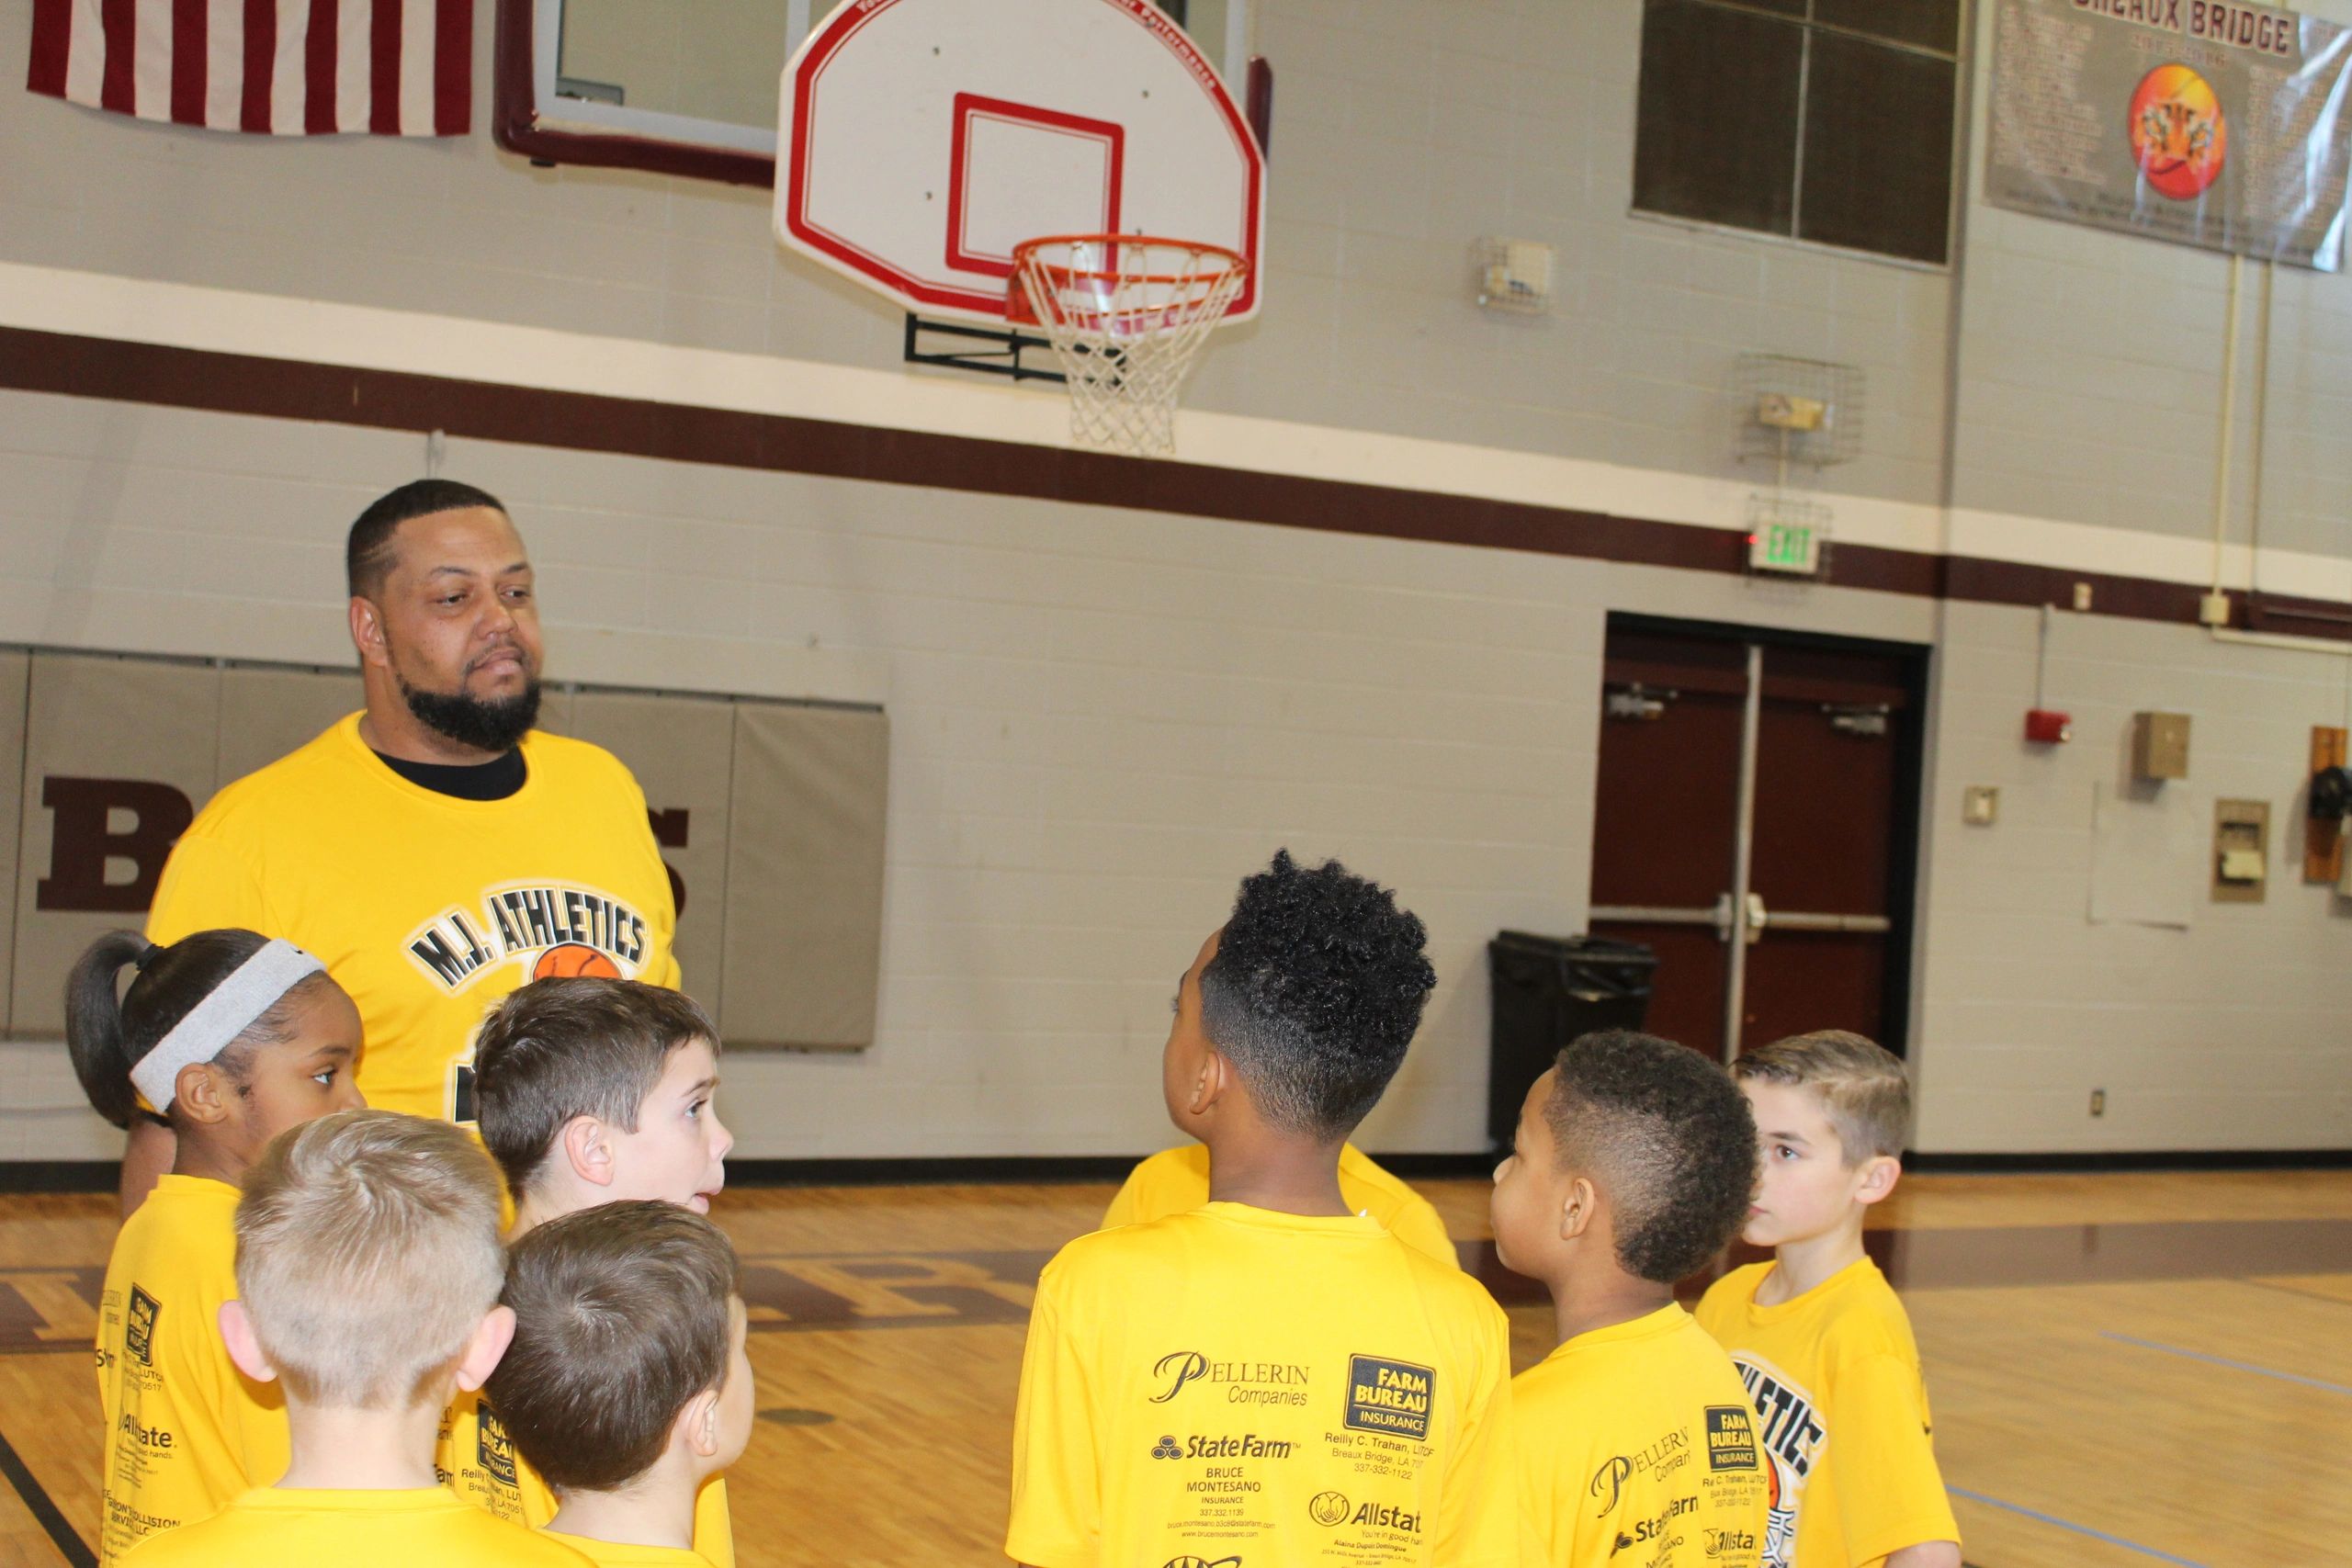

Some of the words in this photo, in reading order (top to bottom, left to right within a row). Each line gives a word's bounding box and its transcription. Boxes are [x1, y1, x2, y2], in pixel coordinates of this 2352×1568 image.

[2191, 0, 2290, 54] BRIDGE
[1766, 524, 1811, 566] EXIT
[411, 912, 494, 987] M.J.
[490, 888, 647, 965] ATHLETICS
[1148, 1350, 1311, 1404] PELLERIN
[1377, 1367, 1428, 1394] FARM
[1228, 1385, 1308, 1408] Companies
[1354, 1383, 1428, 1413] BUREAU
[1360, 1410, 1425, 1432] INSURANCE
[1721, 1413, 1748, 1431] FARM
[1325, 1431, 1354, 1448] Reilly
[1373, 1437, 1411, 1454] Trahan,
[1709, 1430, 1753, 1449] BUREAU
[1332, 1447, 1363, 1459] Breaux
[1397, 1459, 1410, 1467] LA
[1714, 1451, 1755, 1465] INSURANCE
[1205, 1467, 1244, 1479] BRUCE
[1353, 1462, 1414, 1481] 337-332-1122
[1186, 1481, 1262, 1494] MONTESANO
[1201, 1496, 1245, 1506] INSURANCE
[1199, 1508, 1245, 1517] 337.332.1139
[1388, 1532, 1409, 1543] good
